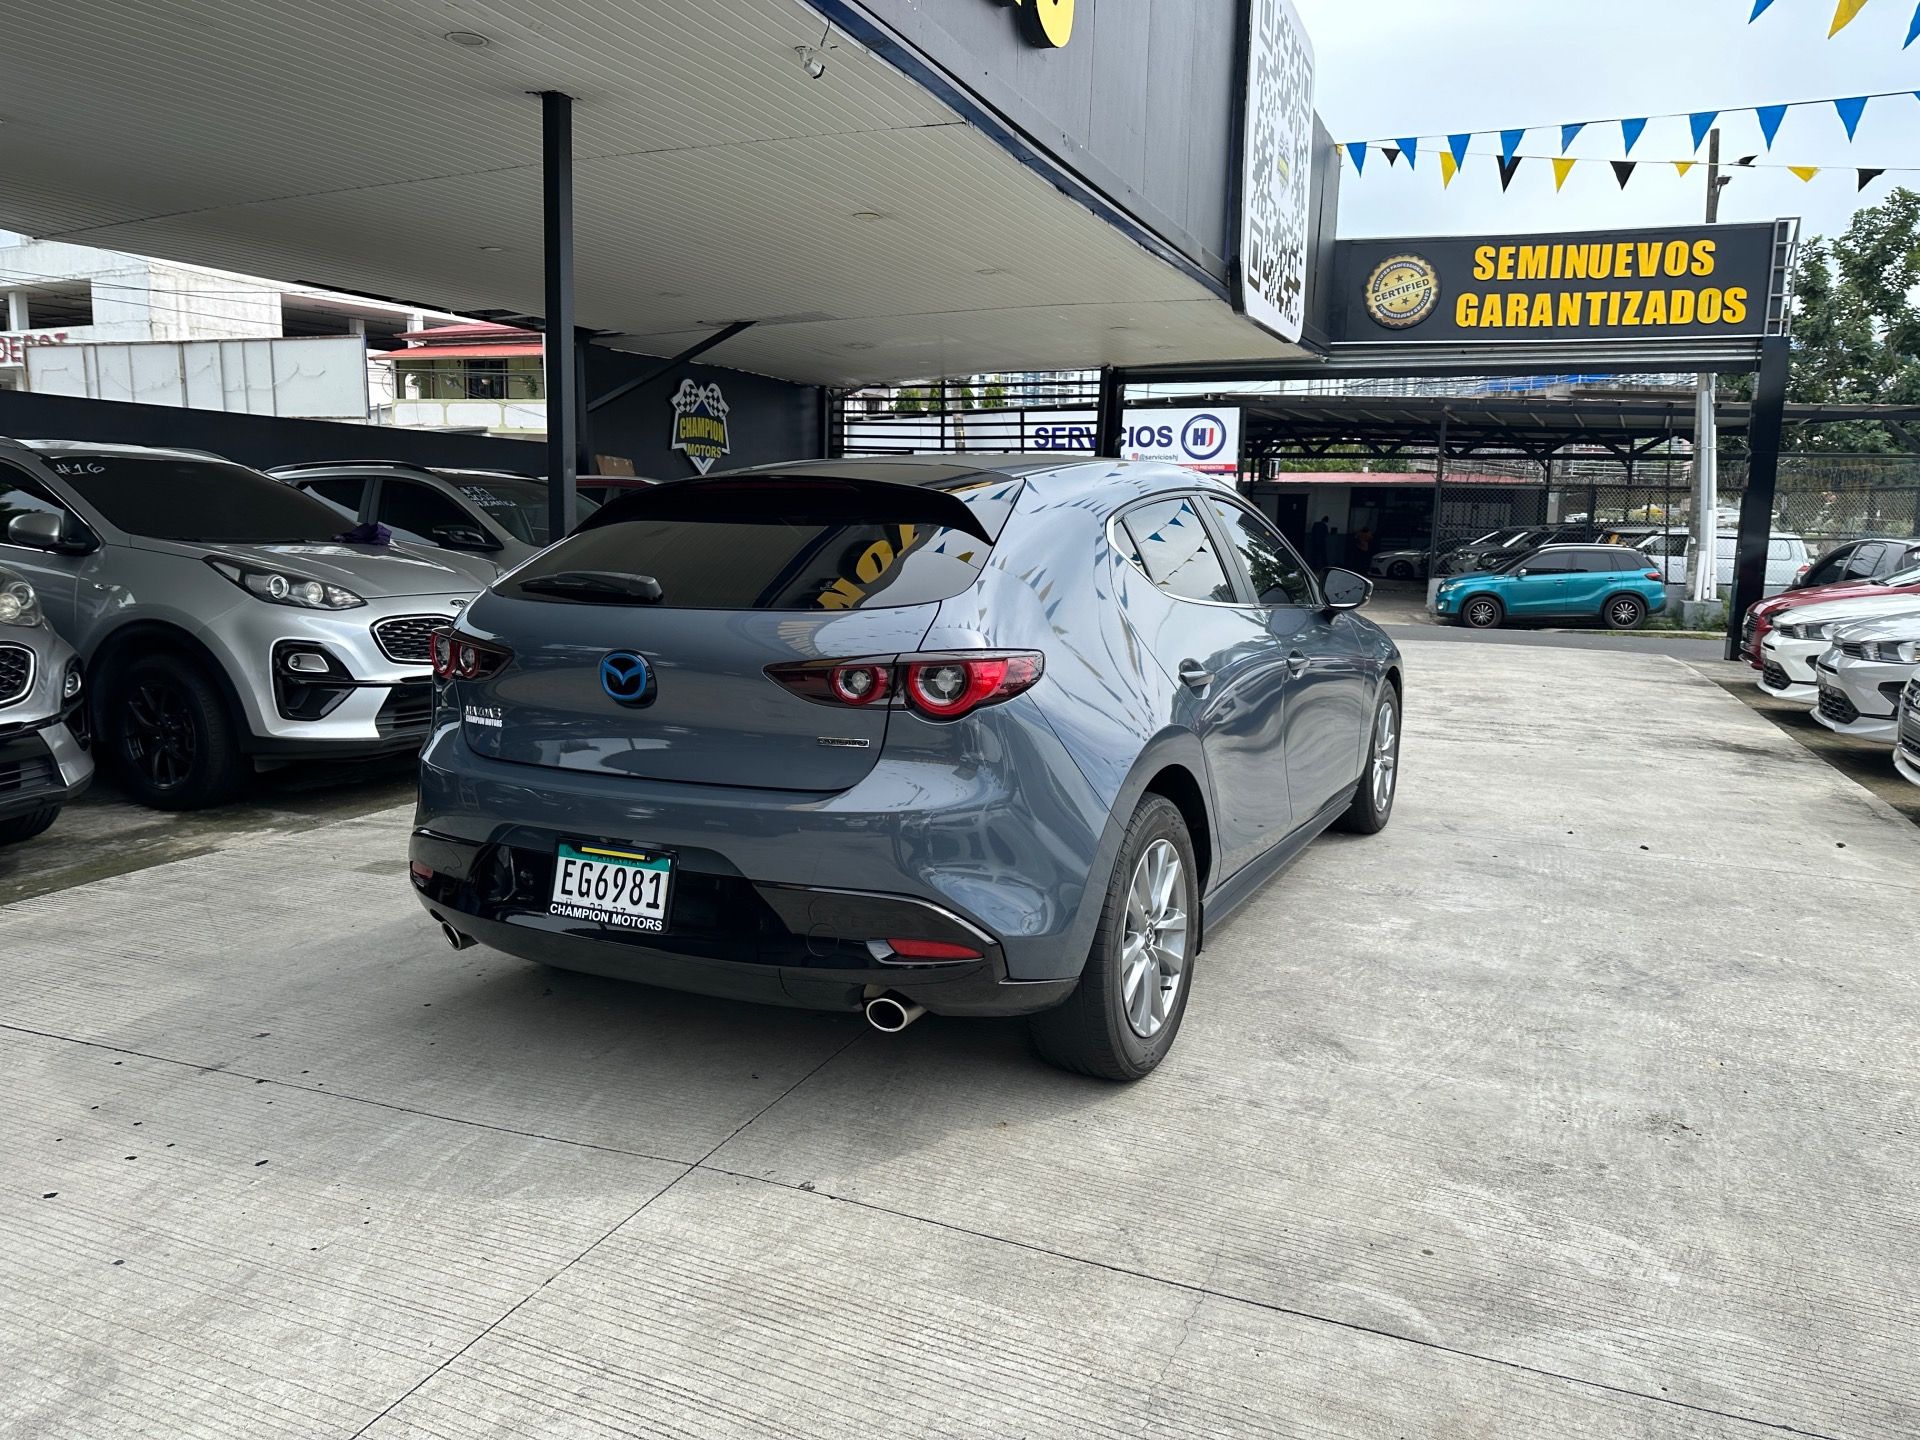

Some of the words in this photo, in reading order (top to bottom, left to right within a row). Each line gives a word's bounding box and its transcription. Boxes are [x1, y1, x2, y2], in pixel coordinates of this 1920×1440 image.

[1473, 239, 1716, 281] SEMINUEVOS
[1374, 278, 1430, 303] CERTIFIED
[1455, 287, 1747, 328] GARANTIZADOS
[680, 416, 724, 444] CHAMPION
[1034, 425, 1173, 449] SERVIOS
[1192, 427, 1214, 448] HJ
[687, 443, 722, 459] MOTORS
[55, 462, 105, 475] #16
[560, 858, 662, 910] EG6981
[549, 903, 609, 923] CHAMPION
[611, 913, 663, 932] MOTORS
